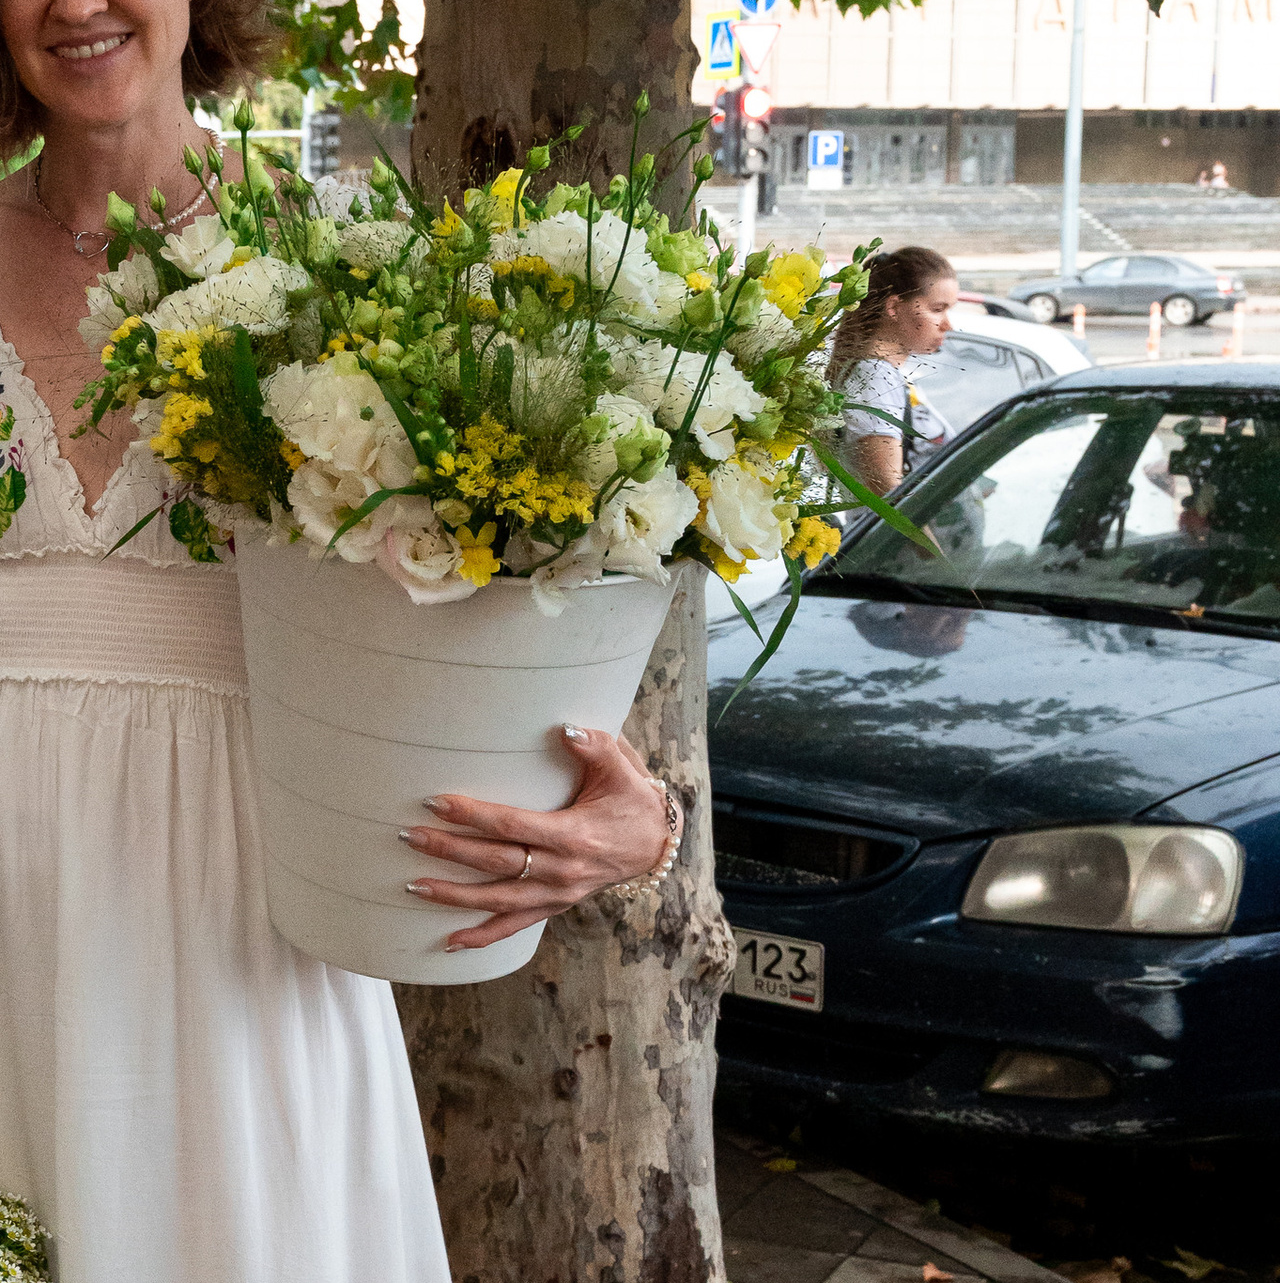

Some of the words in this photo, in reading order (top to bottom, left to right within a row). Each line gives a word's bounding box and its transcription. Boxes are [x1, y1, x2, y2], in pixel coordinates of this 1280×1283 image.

[816, 135, 838, 166] P
[741, 939, 808, 985] 123
[754, 979, 789, 998] RUS
